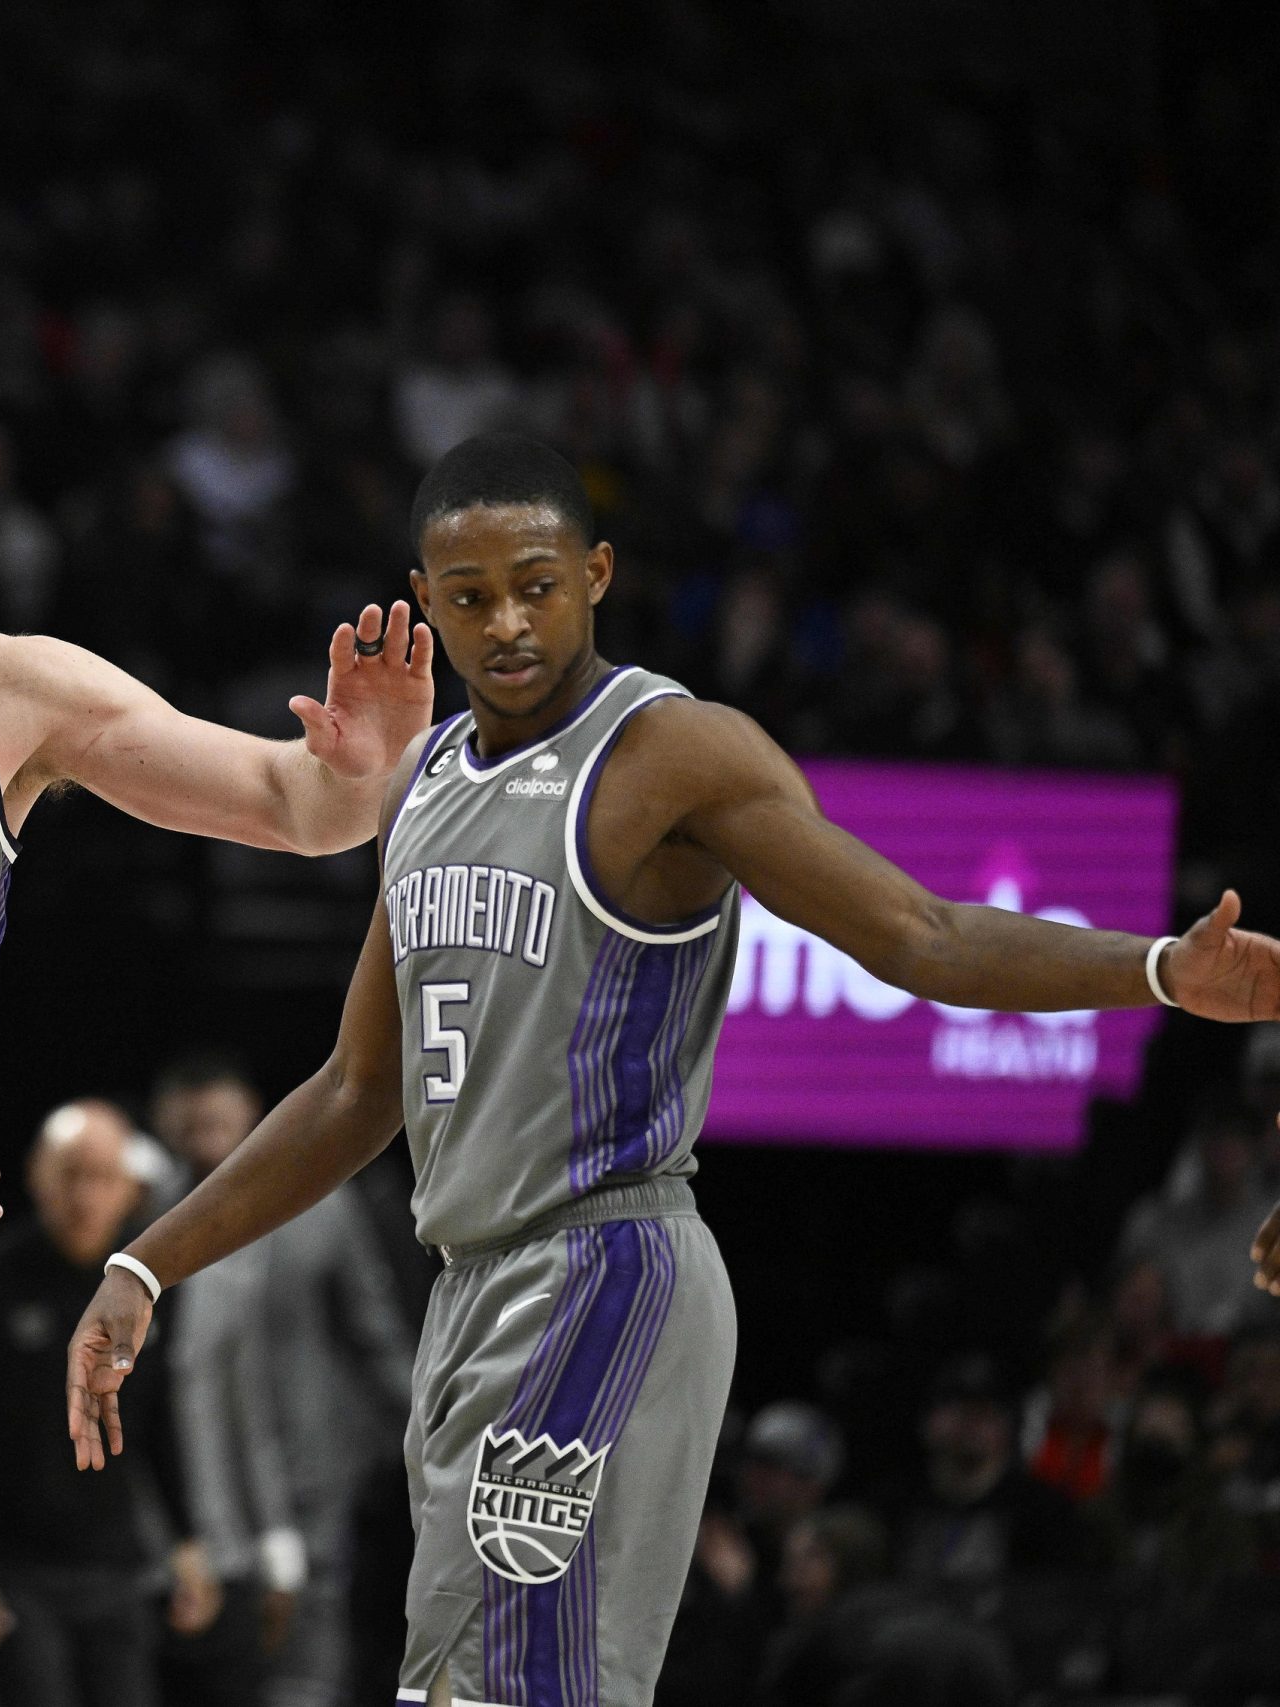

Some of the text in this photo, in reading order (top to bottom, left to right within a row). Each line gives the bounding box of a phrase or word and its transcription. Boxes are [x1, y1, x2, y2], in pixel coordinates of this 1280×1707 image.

[431, 748, 455, 774] 6
[505, 777, 568, 797] dialpad
[386, 864, 557, 969] ACRAMENTO
[420, 981, 470, 1105] 5
[480, 1471, 594, 1499] SACRAMENTO
[471, 1486, 591, 1532] KINGS
